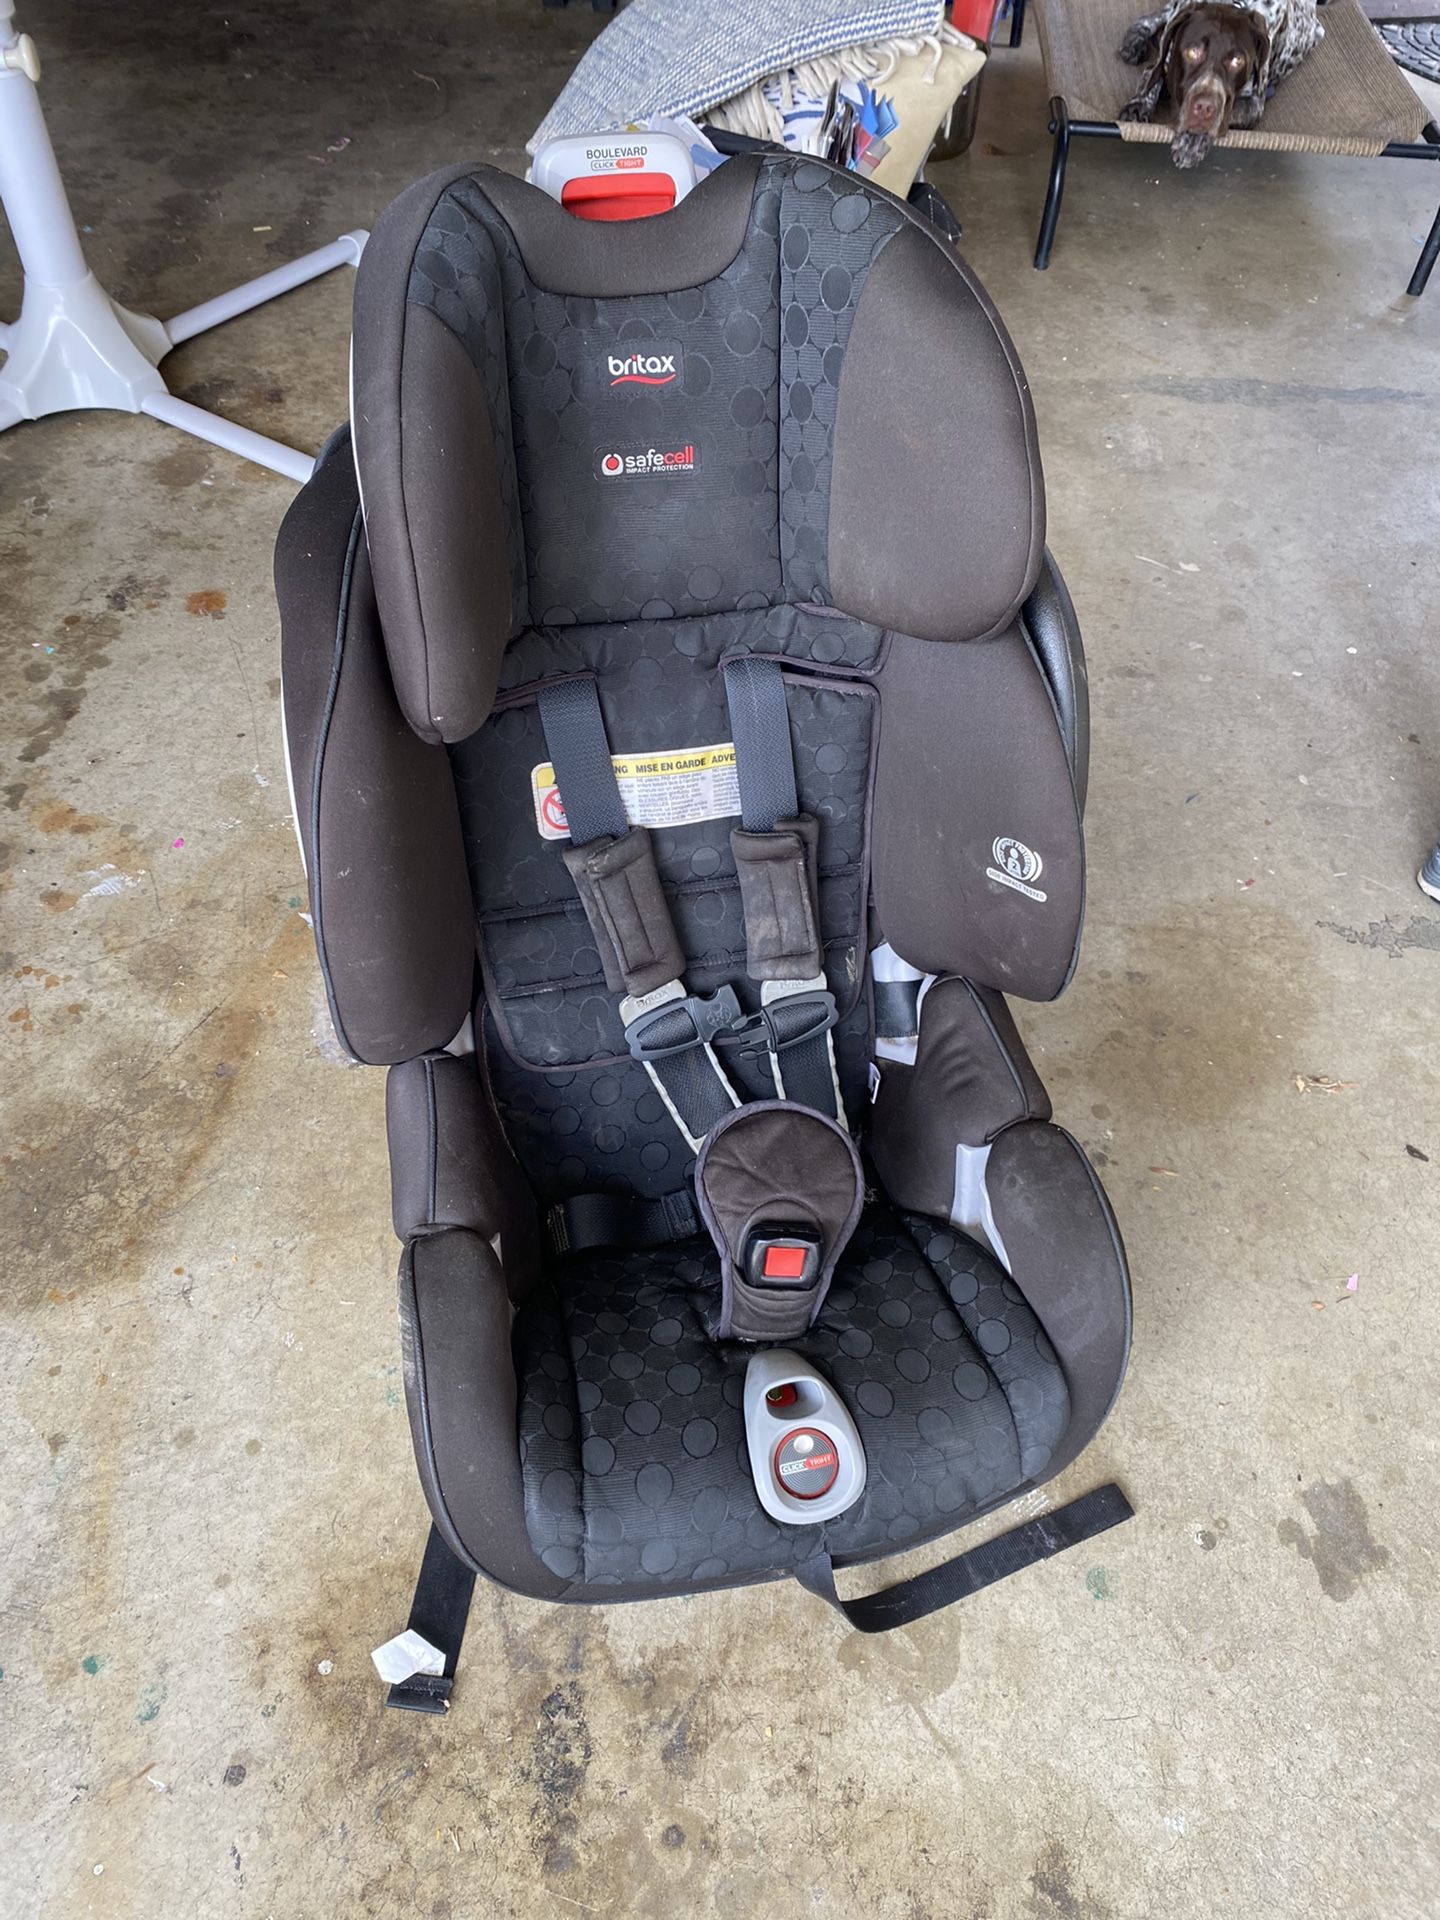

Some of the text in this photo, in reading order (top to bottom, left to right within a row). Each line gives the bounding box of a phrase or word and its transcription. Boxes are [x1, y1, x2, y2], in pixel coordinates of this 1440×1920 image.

[586, 146, 648, 159] BOULEVARD
[593, 159, 642, 169] CLICK TIGHT
[608, 354, 675, 375] britax
[625, 445, 694, 467] safecell
[652, 463, 694, 472] PROTECTION
[636, 763, 659, 773] MISE
[661, 762, 673, 771] EN
[676, 757, 706, 769] GARDE
[782, 1461, 805, 1474] CLICK
